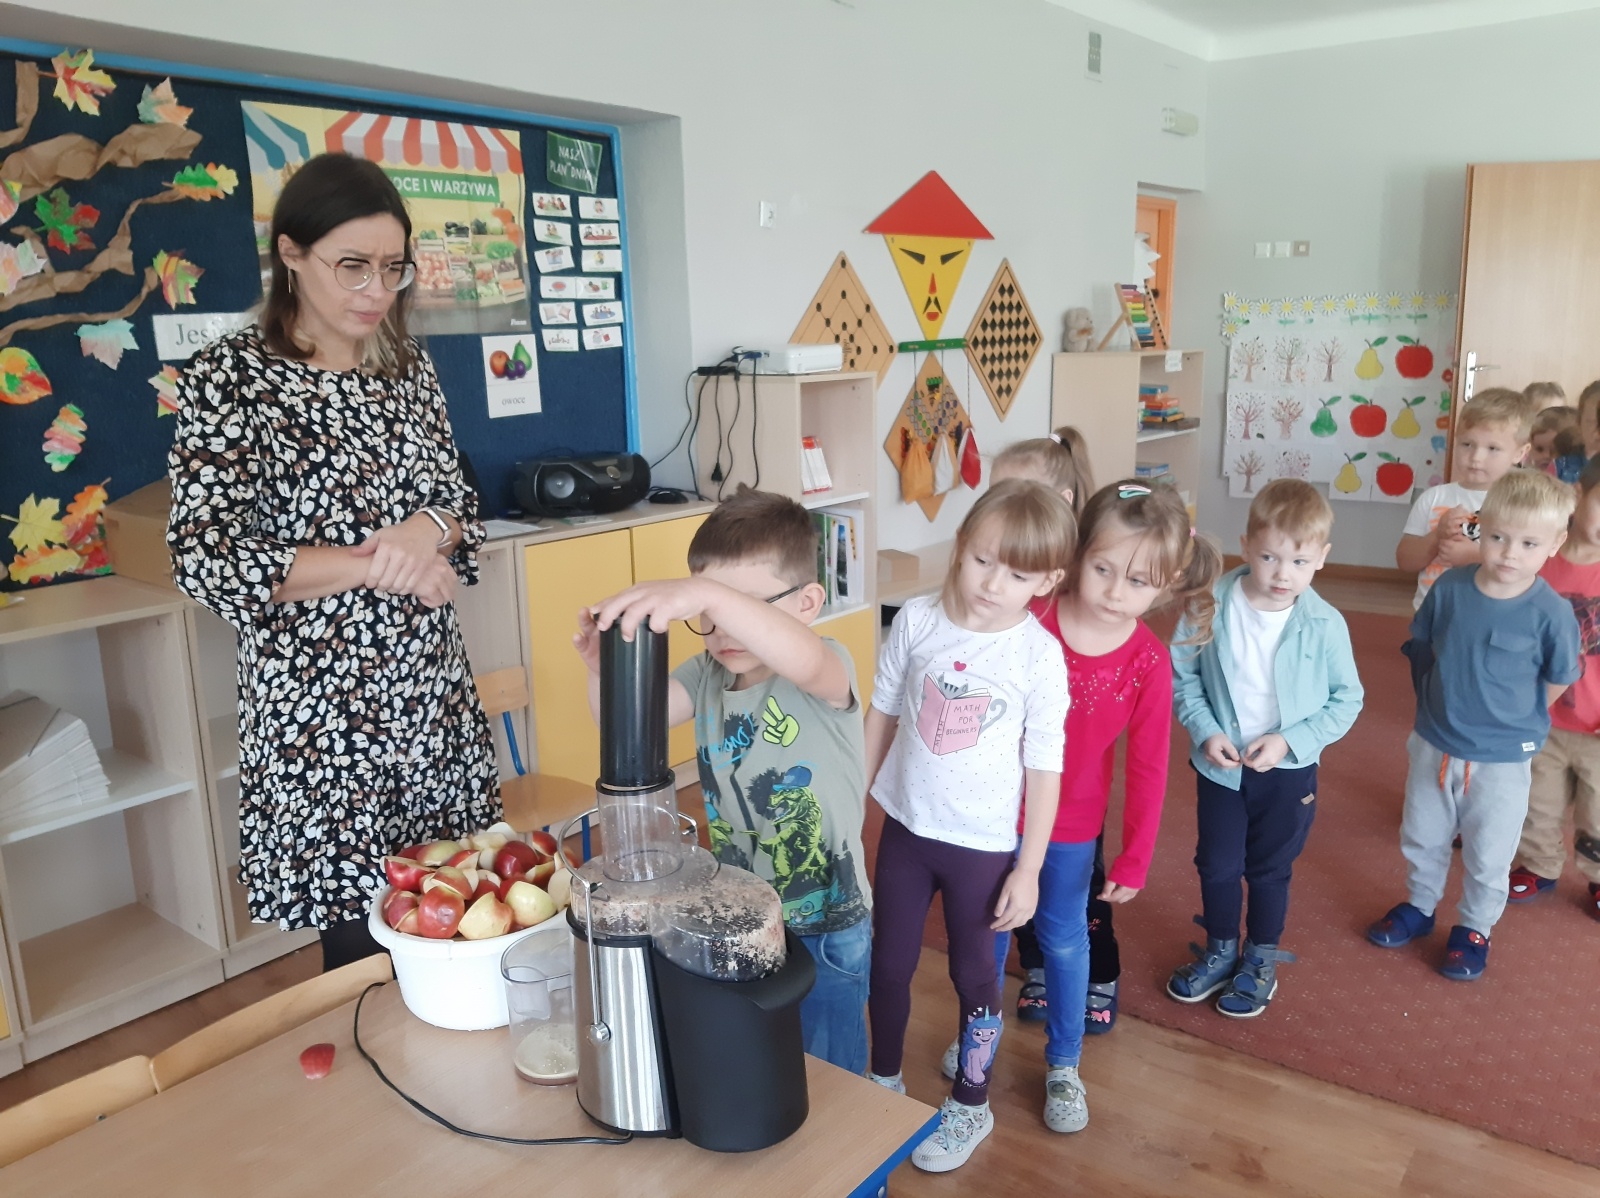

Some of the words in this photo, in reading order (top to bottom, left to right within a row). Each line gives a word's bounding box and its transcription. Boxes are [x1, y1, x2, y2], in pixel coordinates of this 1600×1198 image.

[549, 160, 567, 176] PLAN
[391, 177, 420, 191] OCE
[423, 178, 428, 192] I
[430, 179, 496, 197] WARZYWA
[953, 704, 981, 713] MATH
[958, 716, 974, 725] FOR
[945, 727, 978, 736] BEGINNERS
